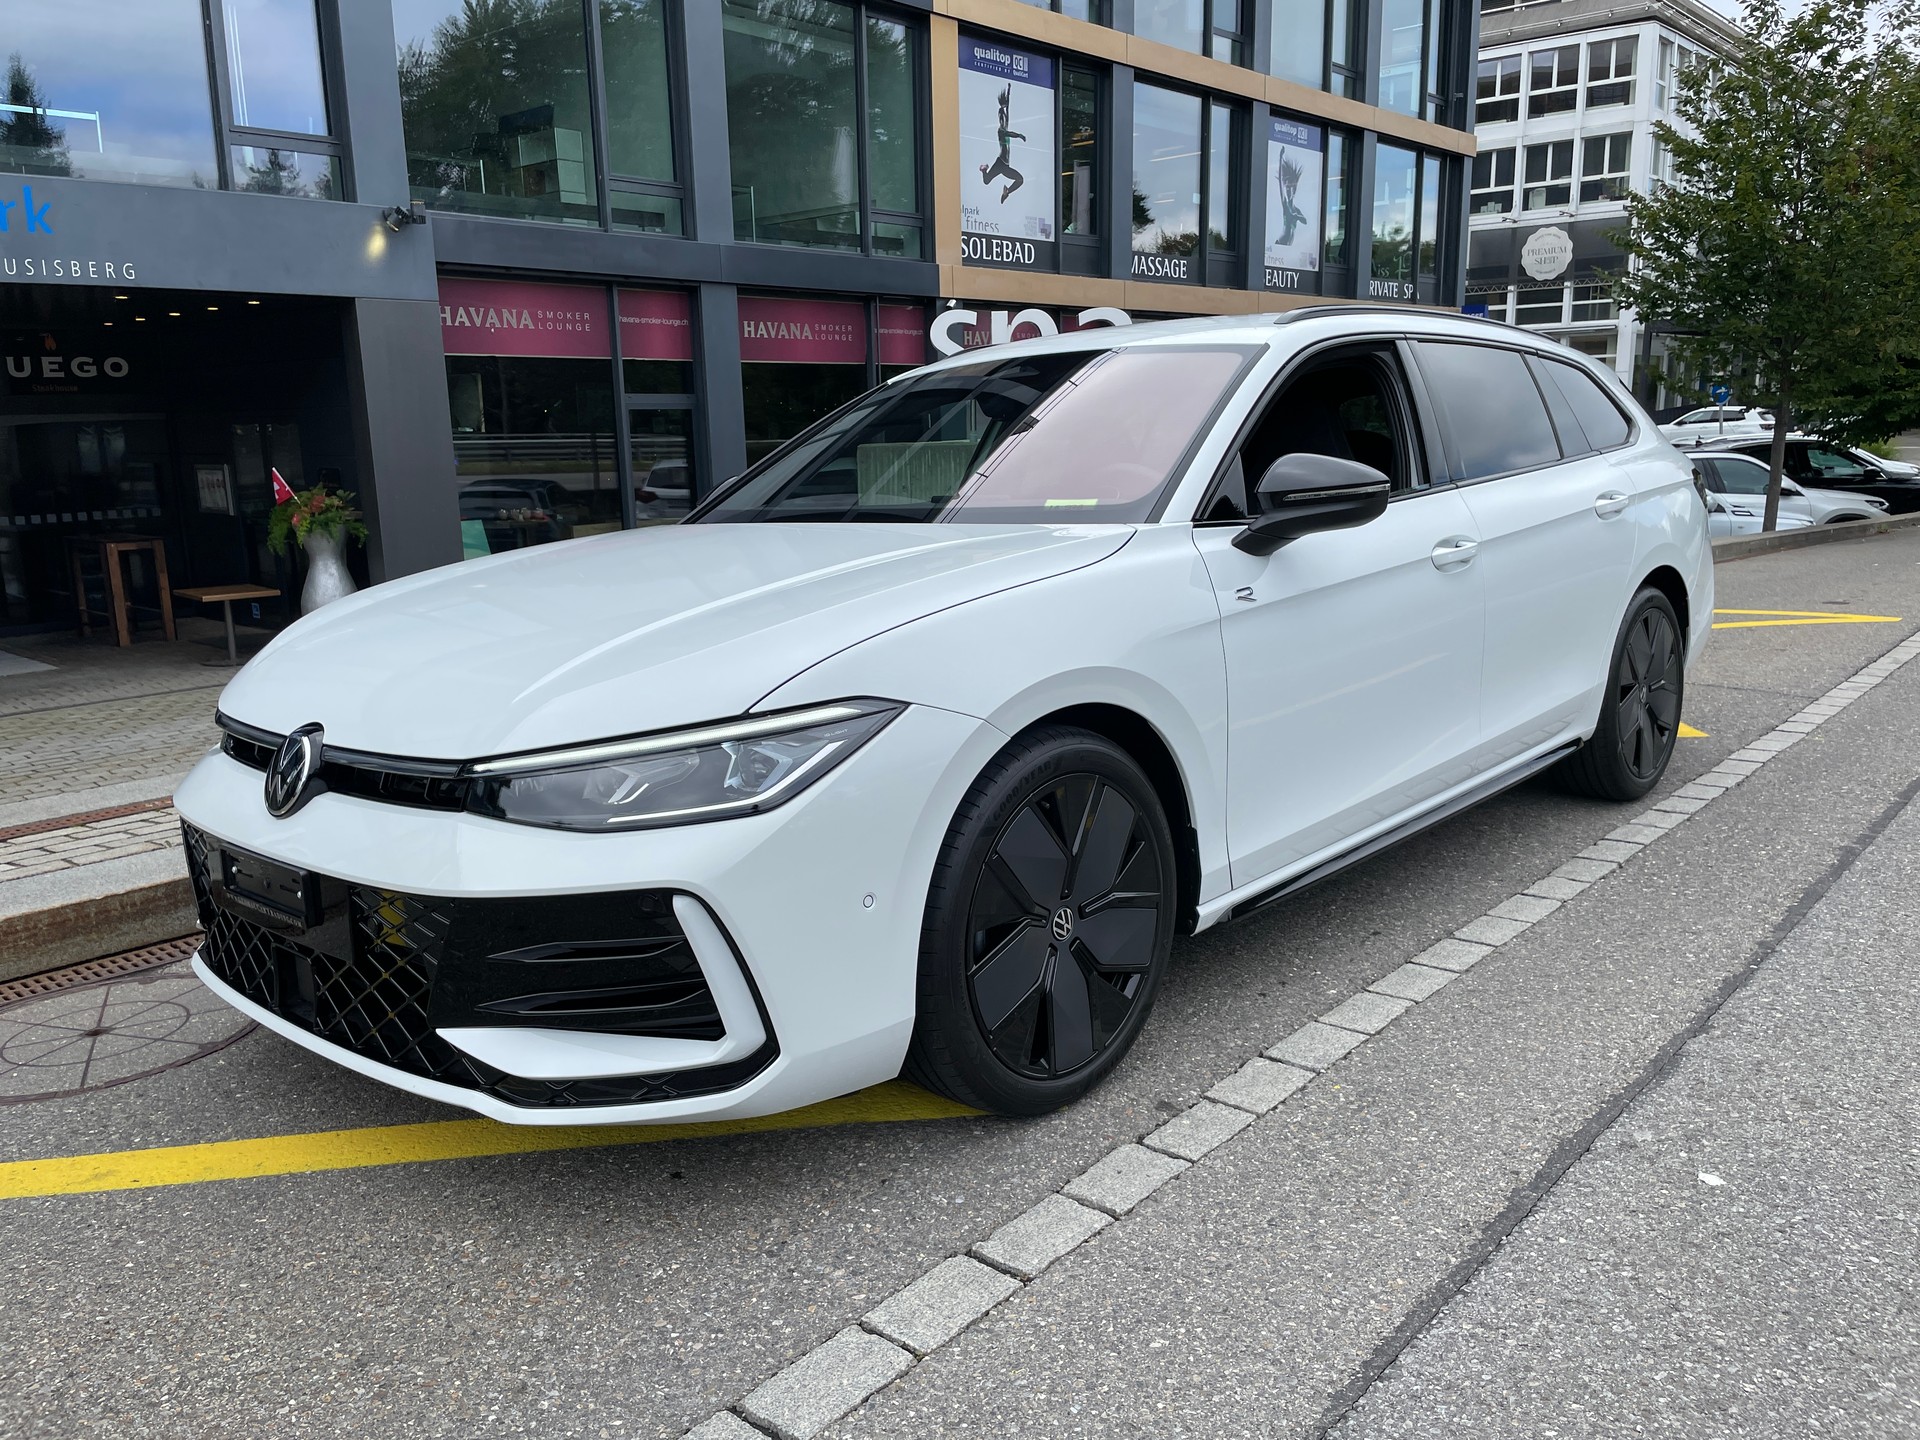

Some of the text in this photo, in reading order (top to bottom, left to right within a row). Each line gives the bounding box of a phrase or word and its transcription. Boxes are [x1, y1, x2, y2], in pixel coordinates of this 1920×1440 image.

[974, 47, 1011, 66] qualitop
[1274, 122, 1297, 136] qualitop
[965, 216, 1000, 233] fitness
[961, 236, 1035, 264] SOLEBAD
[1527, 246, 1567, 257] PREMIUM
[4, 258, 136, 280] USISBERG
[1265, 269, 1300, 289] EAUTY
[1369, 280, 1420, 299] RIVATE SP
[439, 306, 535, 329] HAVANA
[538, 310, 591, 321] SMOKER
[538, 322, 591, 332] LOUNGE
[743, 320, 813, 340] HAVANA
[815, 323, 853, 332] SMOKER
[815, 333, 853, 342] LOUNGE
[963, 330, 990, 346] HAV
[5, 356, 129, 378] UEGO
